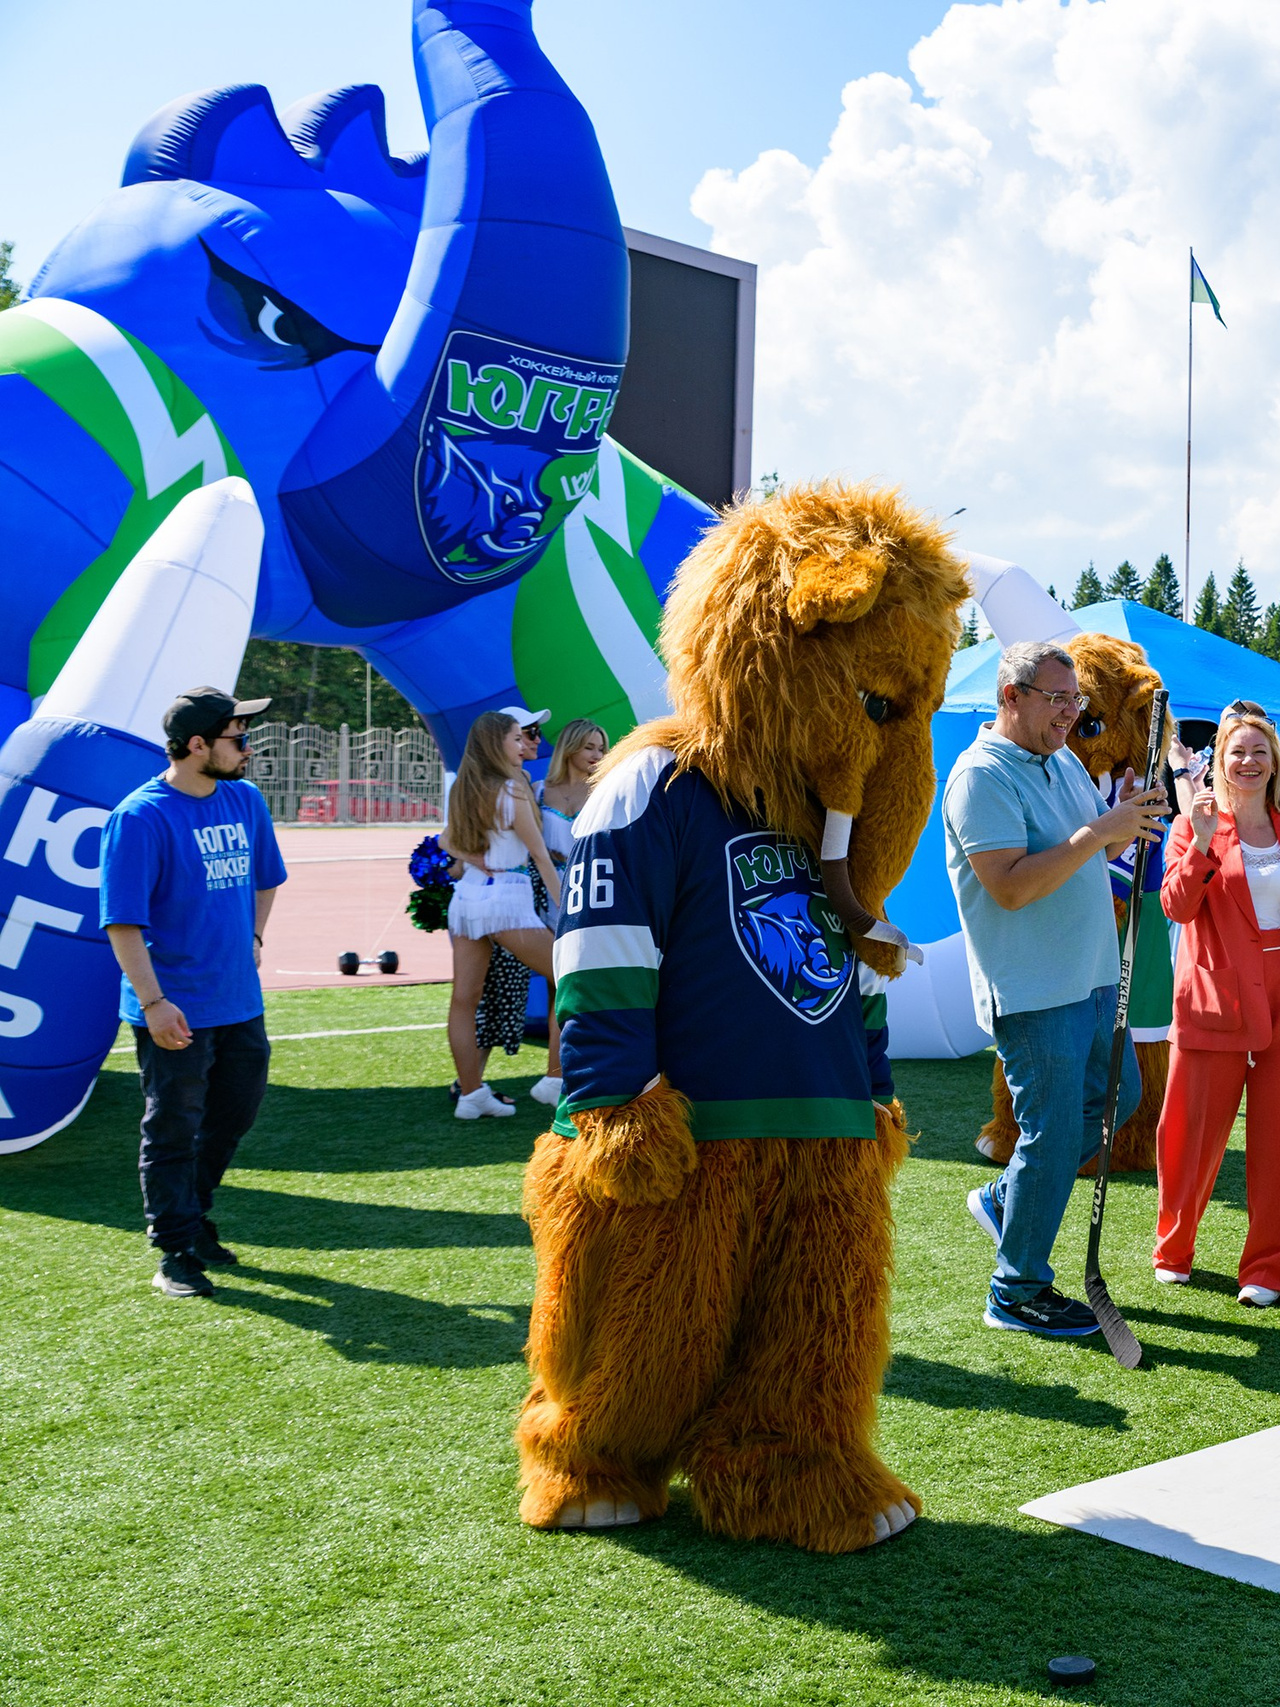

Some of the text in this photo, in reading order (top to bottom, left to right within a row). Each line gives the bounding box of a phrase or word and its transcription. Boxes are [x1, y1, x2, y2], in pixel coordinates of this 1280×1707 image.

[507, 354, 597, 382] ХОККЕЙНЫЙ
[193, 823, 250, 854] ЮГРА
[567, 858, 614, 915] 86
[1117, 959, 1131, 1013] REKKER
